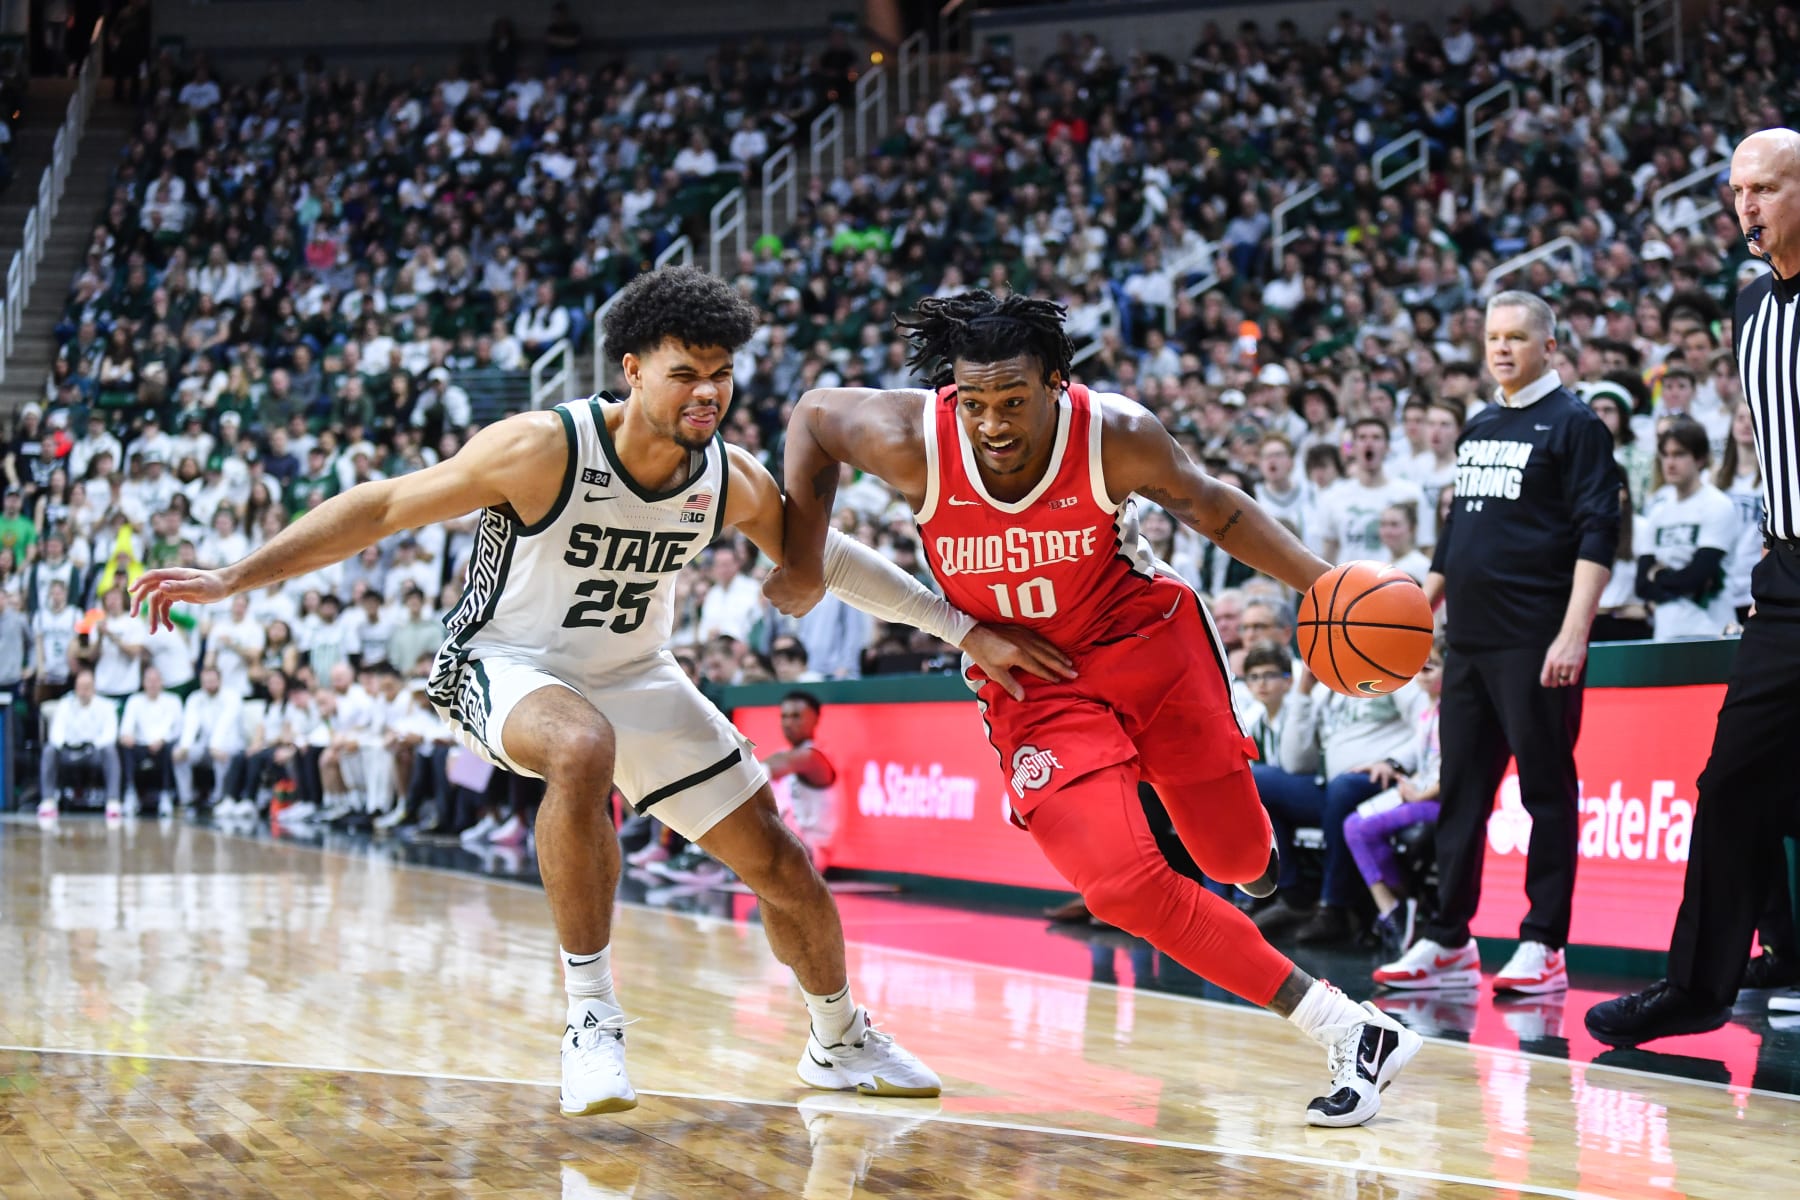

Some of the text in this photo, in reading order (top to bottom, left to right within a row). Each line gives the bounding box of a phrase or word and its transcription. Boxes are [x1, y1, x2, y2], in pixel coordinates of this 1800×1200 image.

[1458, 439, 1534, 470] SPARTAN
[564, 523, 699, 573] STATE
[561, 579, 659, 634] 25
[986, 576, 1057, 619] 10
